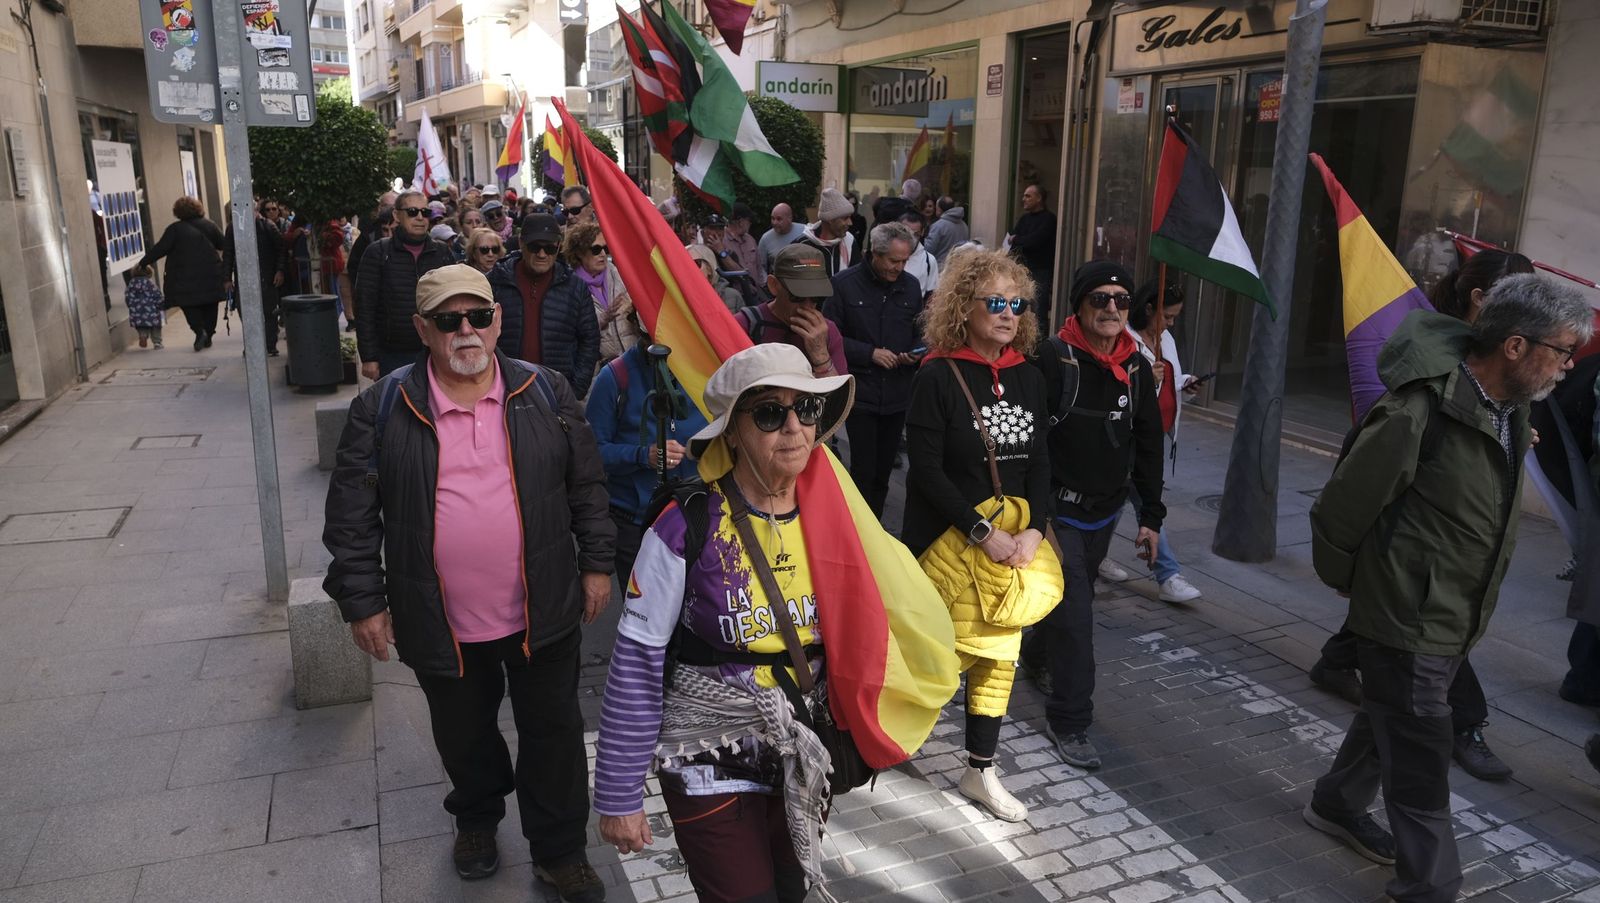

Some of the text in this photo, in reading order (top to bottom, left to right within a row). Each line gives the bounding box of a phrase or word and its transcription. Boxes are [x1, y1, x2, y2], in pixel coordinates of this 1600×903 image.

[1136, 6, 1242, 53] Gales
[765, 77, 833, 95] andarín
[871, 67, 947, 108] andarín
[726, 587, 751, 612] LA
